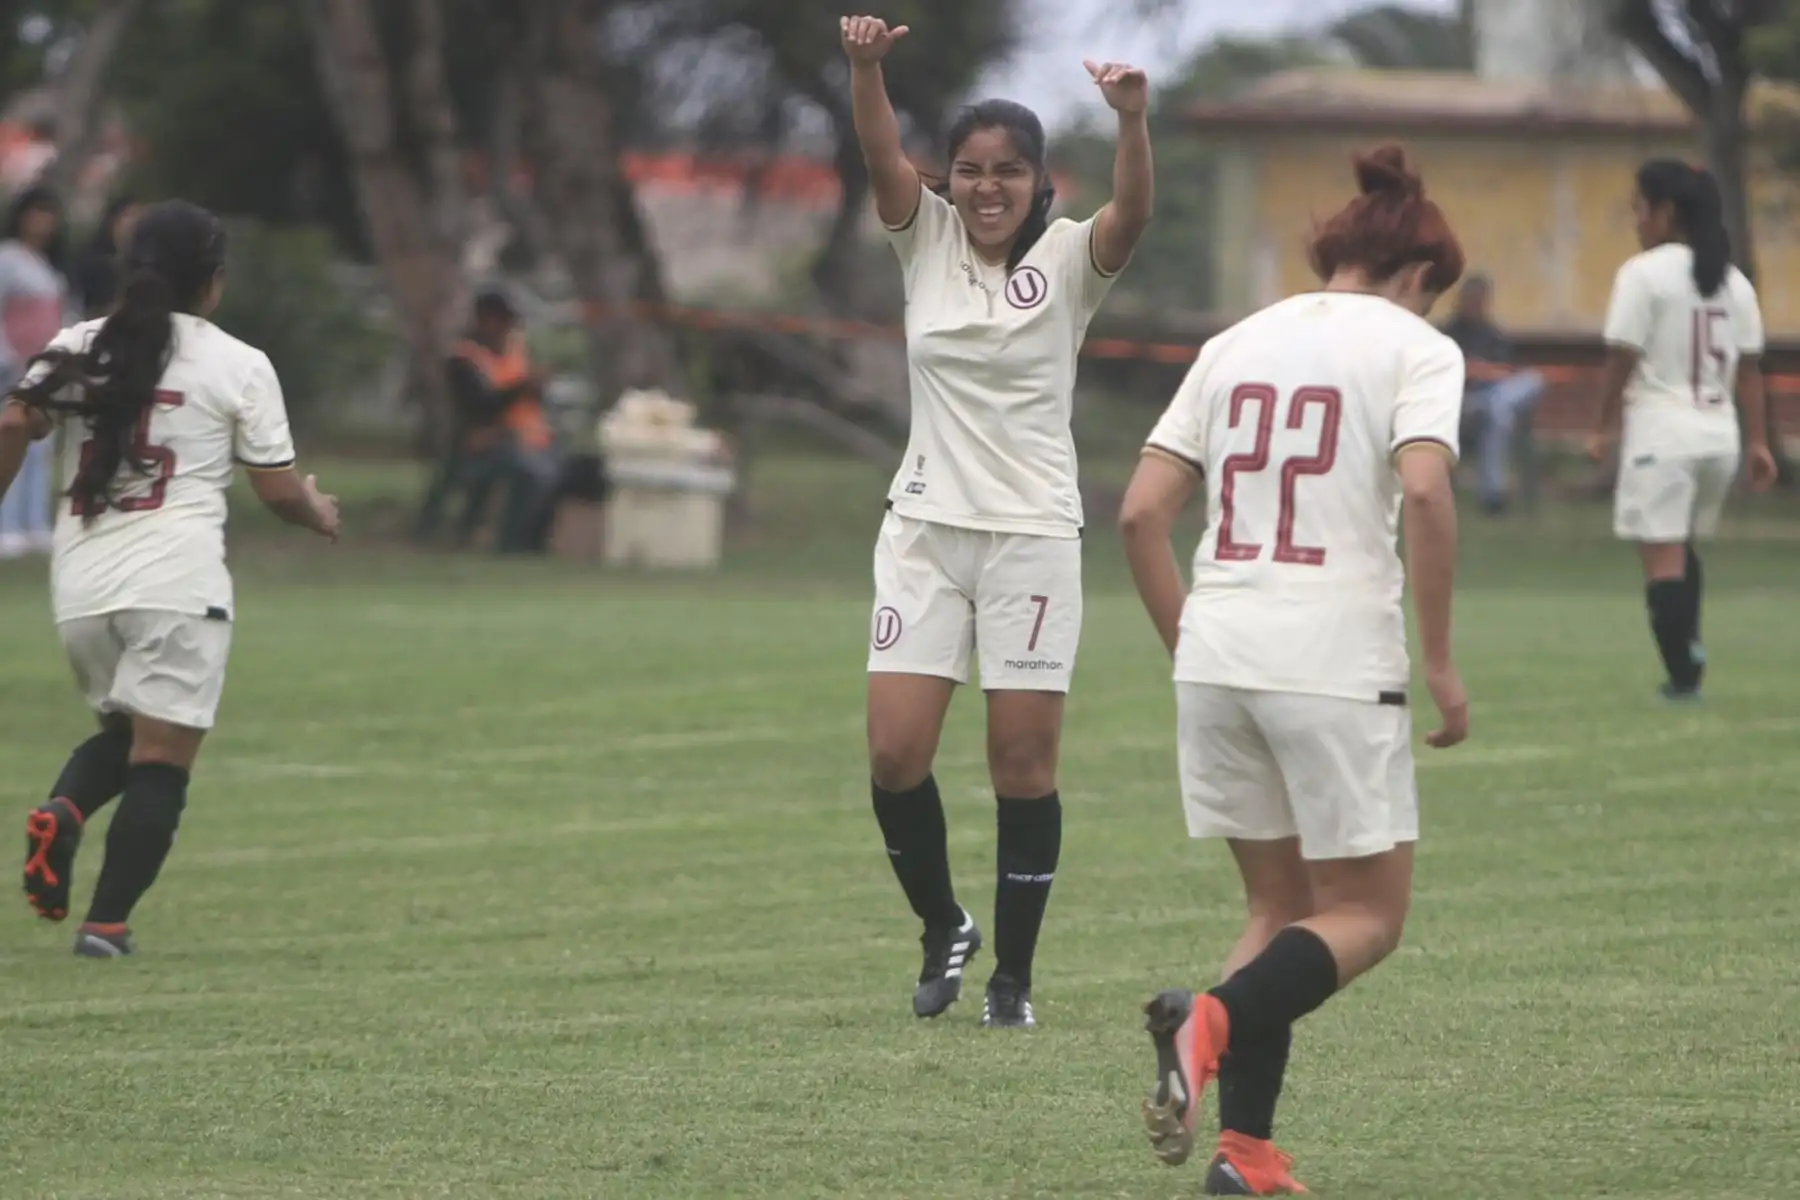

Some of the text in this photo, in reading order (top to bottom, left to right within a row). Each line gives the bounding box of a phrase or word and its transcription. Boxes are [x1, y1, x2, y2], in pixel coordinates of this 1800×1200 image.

[1011, 272, 1039, 304] U
[1690, 307, 1728, 408] 15
[1214, 382, 1342, 566] 22
[1028, 595, 1048, 651] 7
[1005, 658, 1063, 670] marathon
